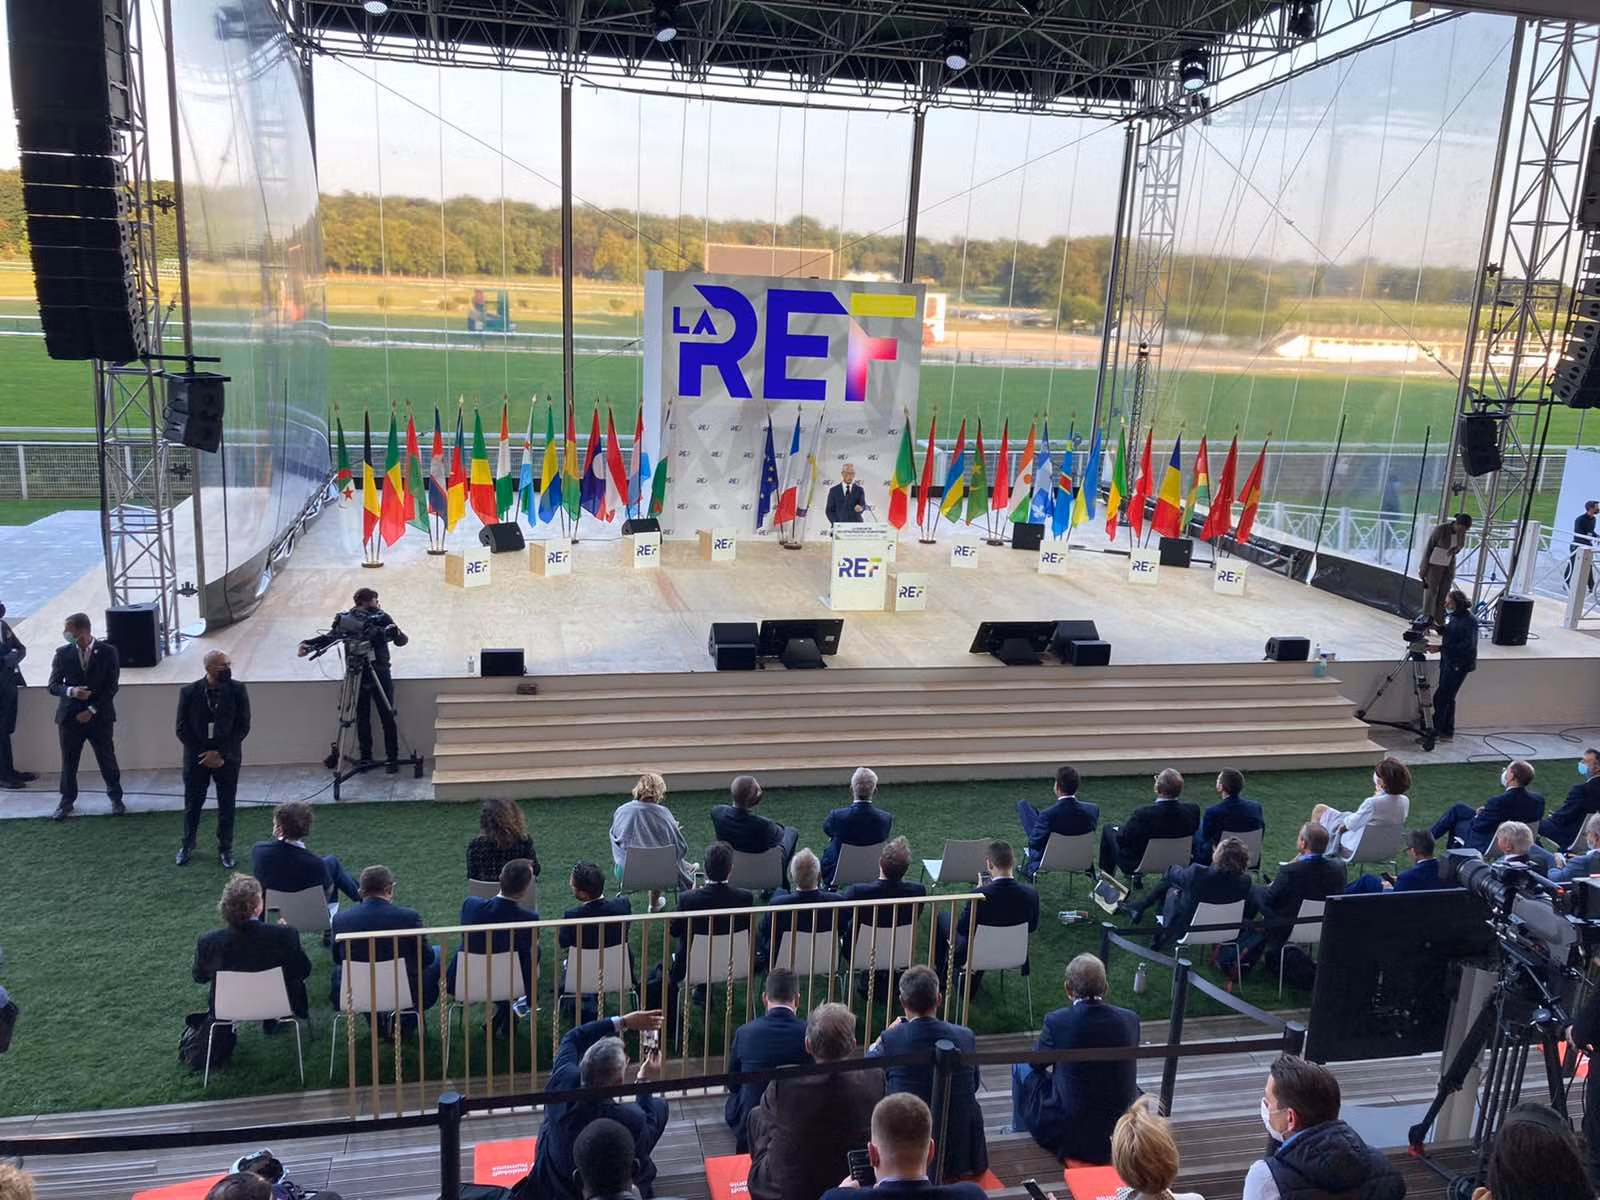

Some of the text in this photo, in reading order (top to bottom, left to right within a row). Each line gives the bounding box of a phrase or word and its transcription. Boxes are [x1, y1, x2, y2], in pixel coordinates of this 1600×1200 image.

[672, 284, 917, 402] LA REF
[838, 557, 882, 578] REF
